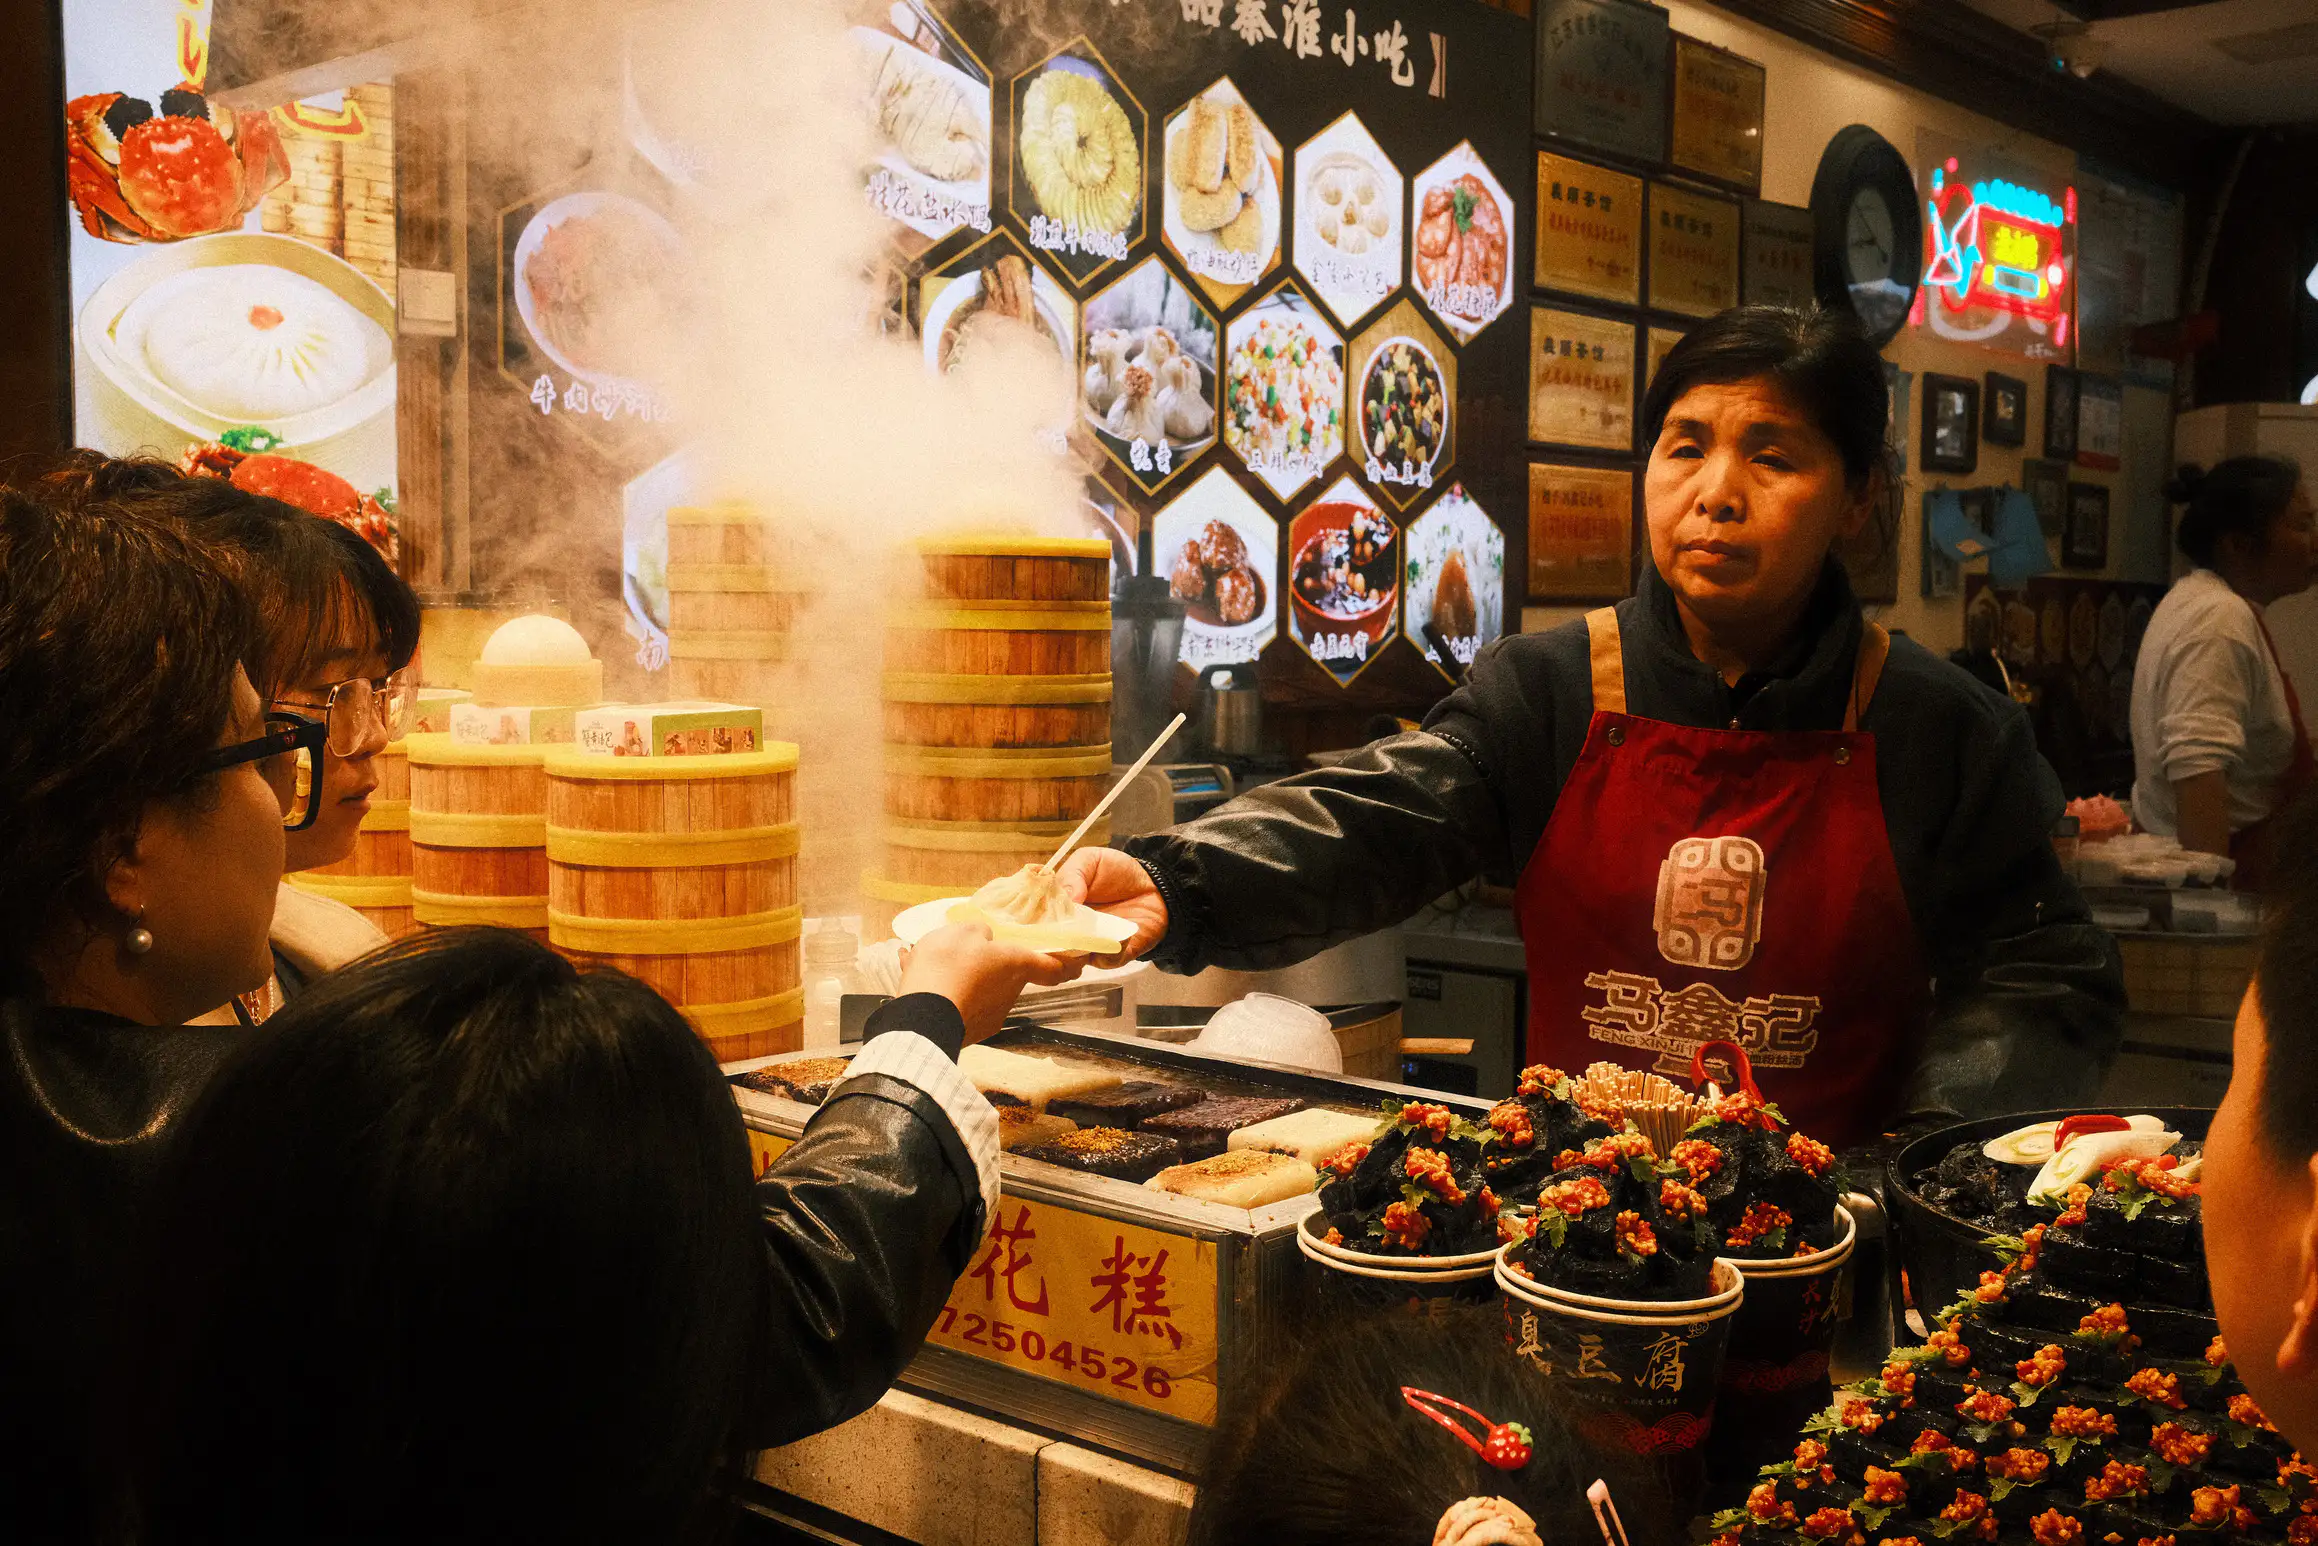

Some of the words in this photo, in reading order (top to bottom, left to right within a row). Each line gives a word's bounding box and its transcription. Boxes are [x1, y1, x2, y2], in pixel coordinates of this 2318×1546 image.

[530, 374, 678, 422] 牛肉炒河
[1591, 1026, 1636, 1044] FENG
[939, 1306, 1173, 1399] 72504526
[1515, 1308, 1688, 1393] 臭豆腐
